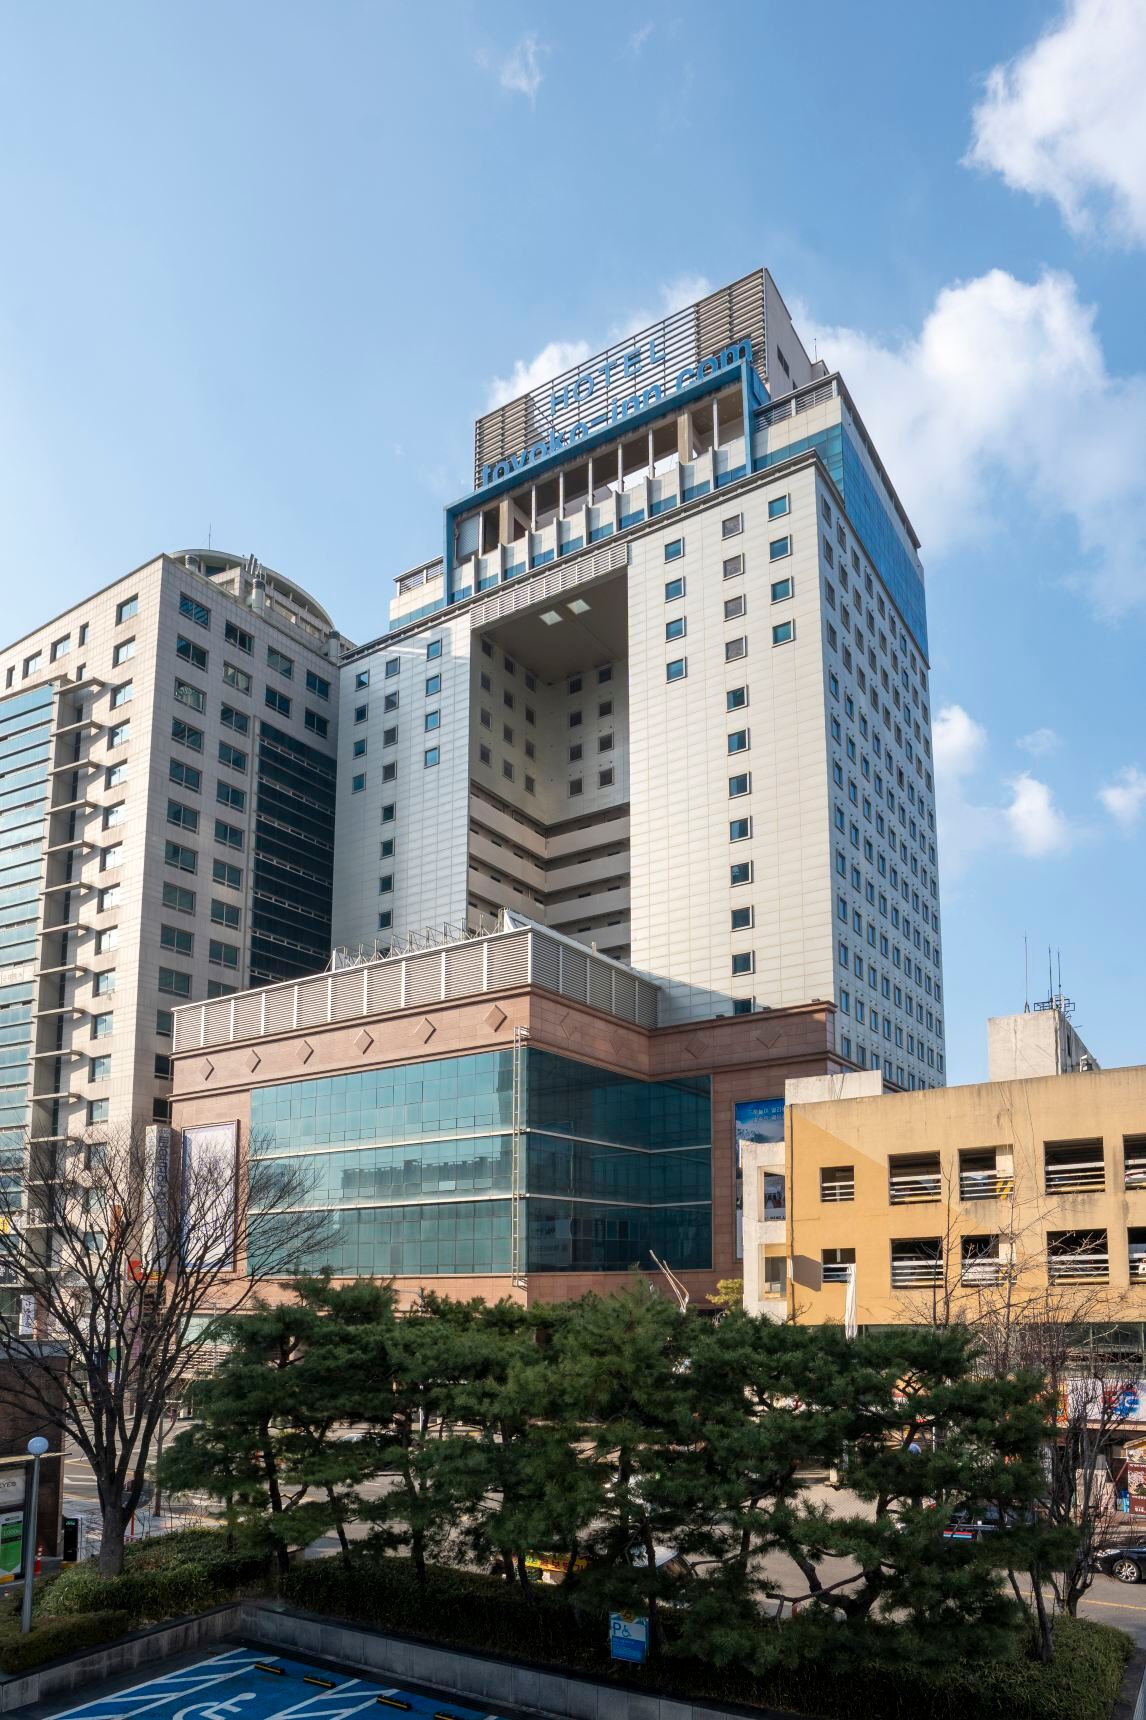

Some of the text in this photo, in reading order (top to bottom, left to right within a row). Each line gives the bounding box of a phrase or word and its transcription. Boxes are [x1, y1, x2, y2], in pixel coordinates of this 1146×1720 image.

[481, 338, 753, 487] toyoko-inncom
[550, 337, 667, 416] HOTEL
[613, 1622, 621, 1634] P
